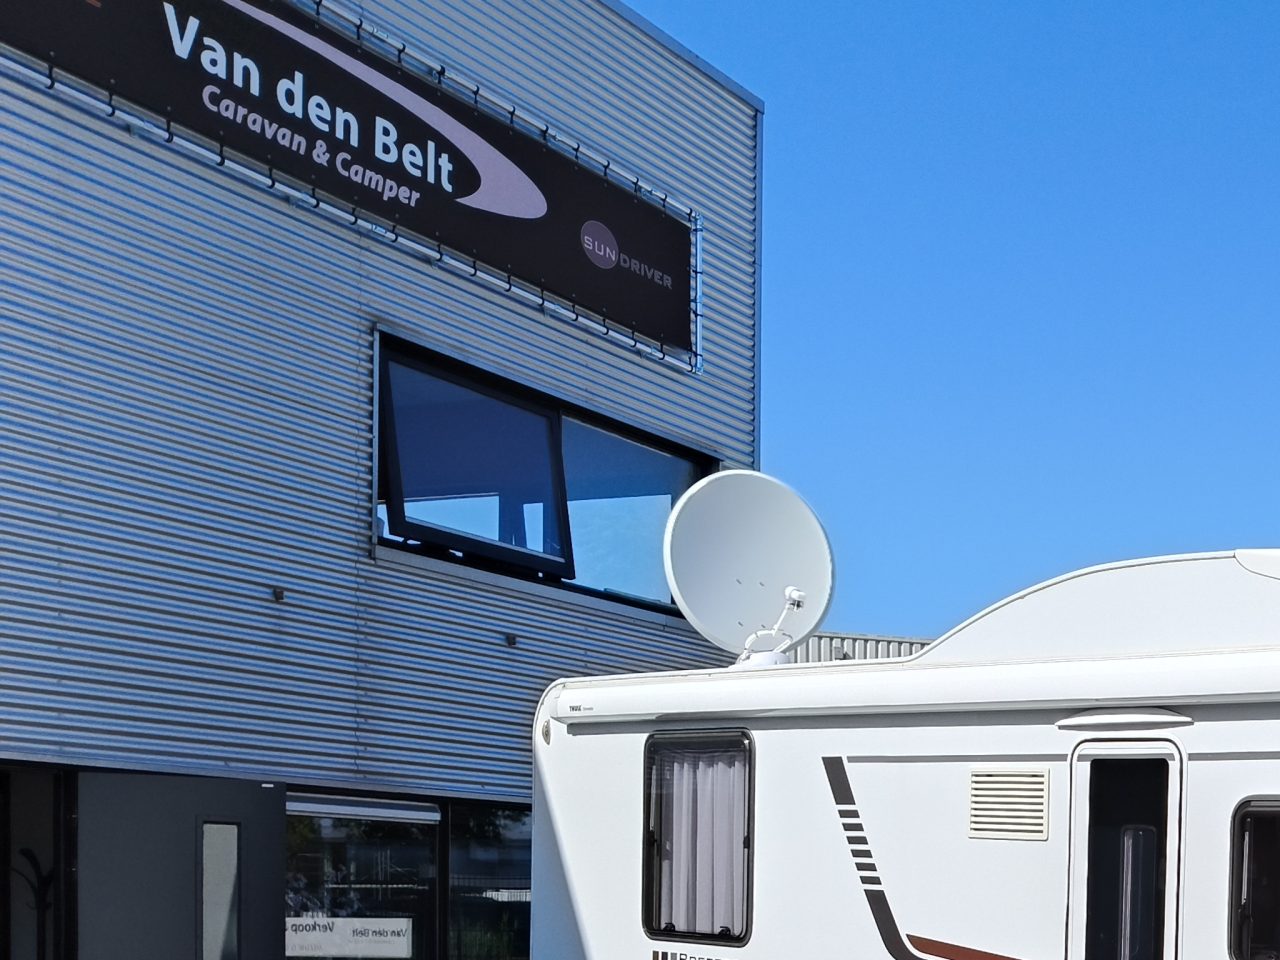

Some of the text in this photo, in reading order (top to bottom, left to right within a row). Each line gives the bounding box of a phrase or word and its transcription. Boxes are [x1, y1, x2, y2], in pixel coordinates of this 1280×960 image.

[163, 2, 453, 192] Van den Belt
[202, 84, 421, 207] Caravan & Camper
